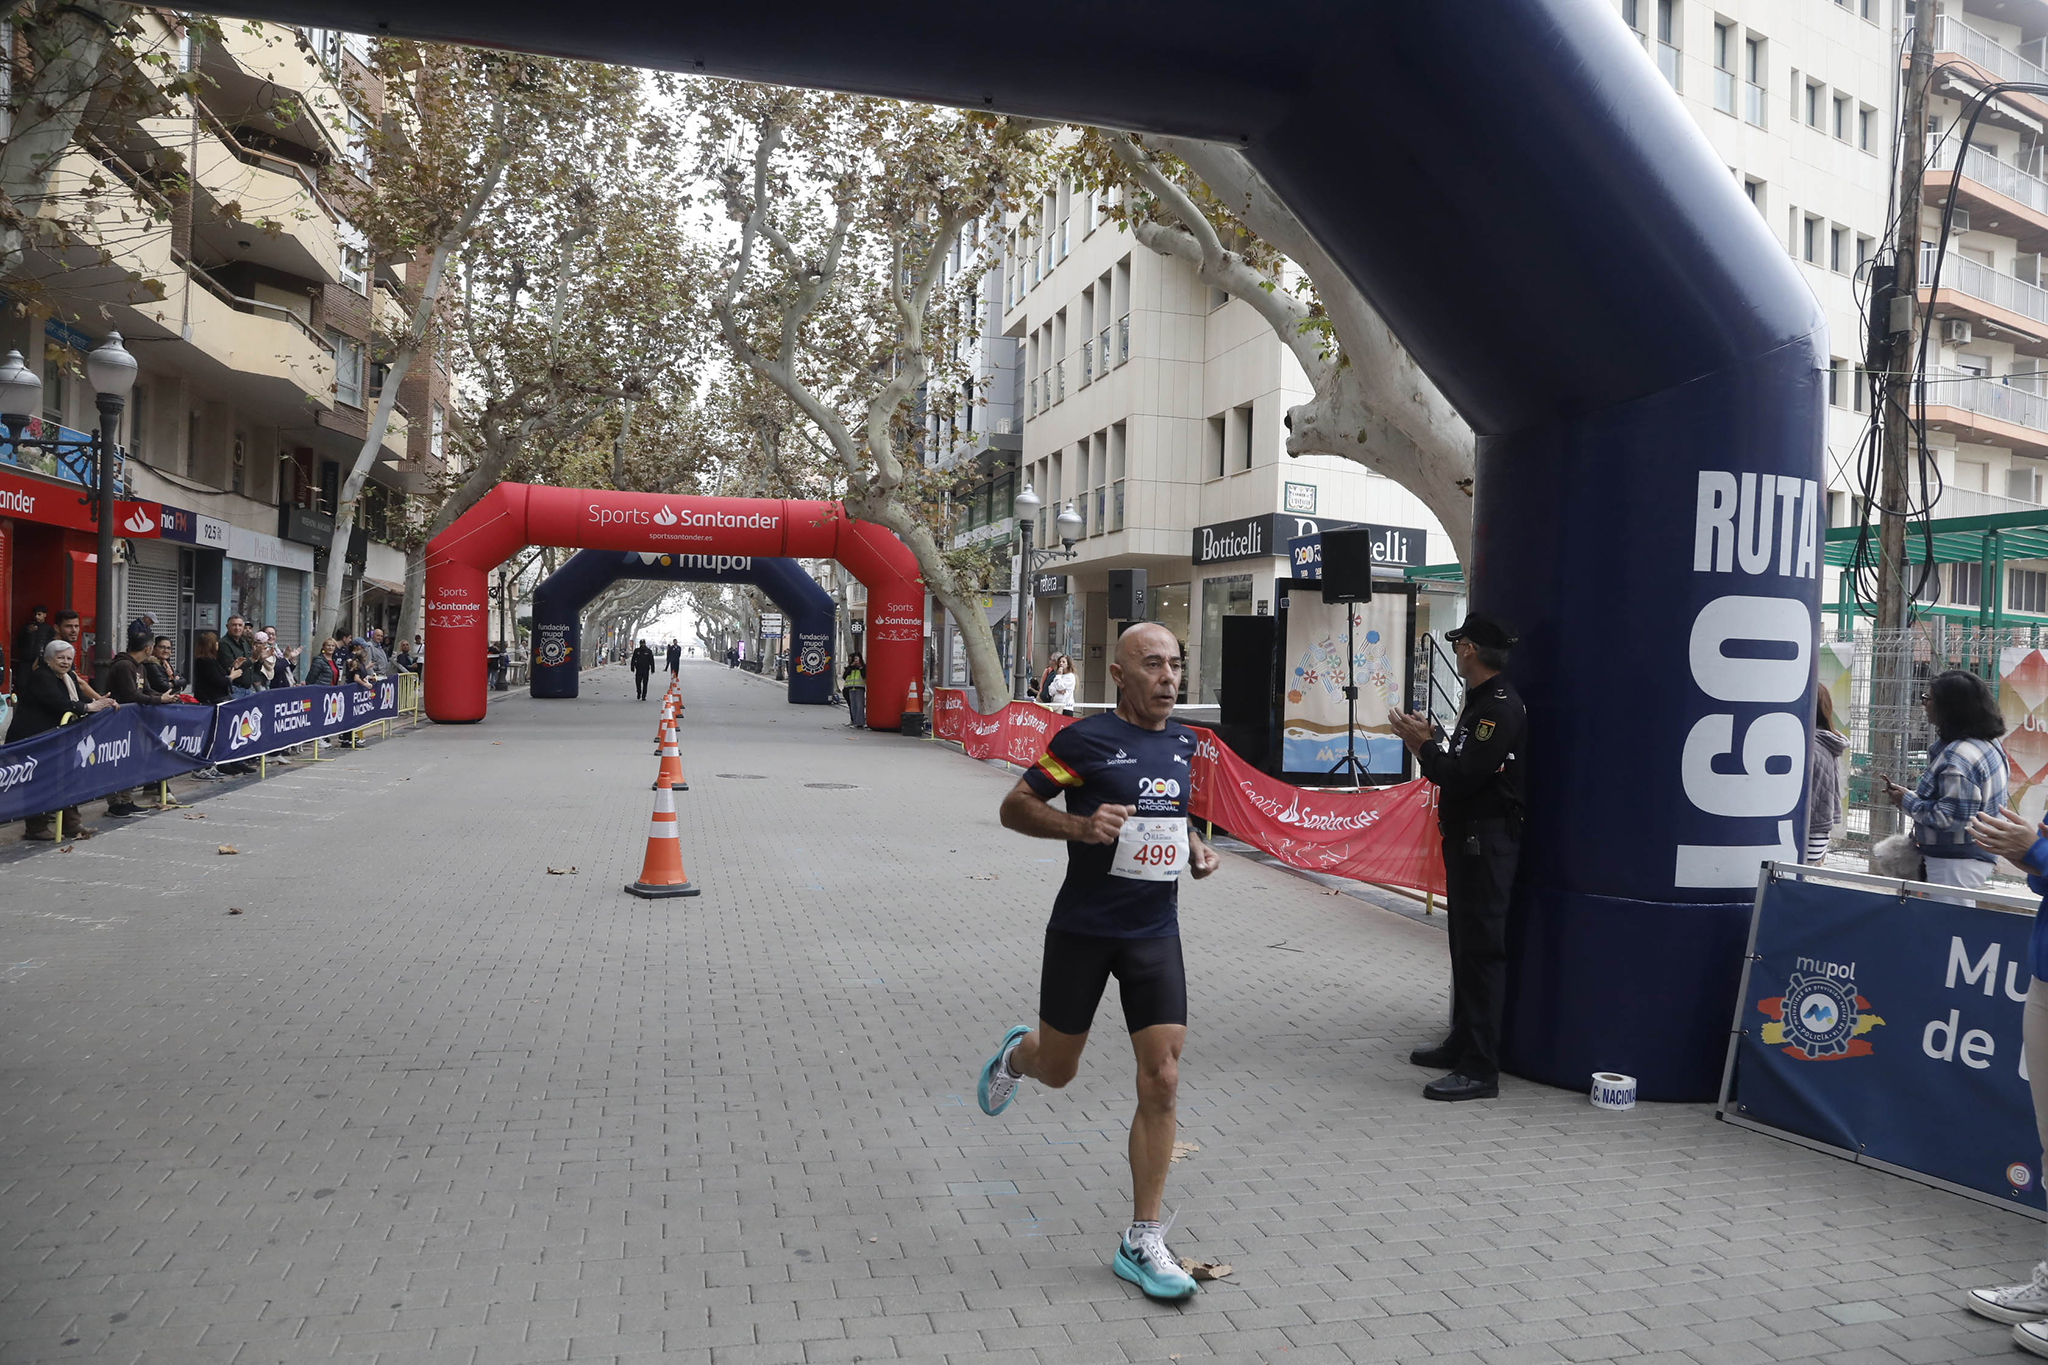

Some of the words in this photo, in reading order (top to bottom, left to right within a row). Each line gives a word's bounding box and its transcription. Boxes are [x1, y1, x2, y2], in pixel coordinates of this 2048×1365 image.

[175, 511, 187, 532] FM
[588, 504, 650, 527] Sports
[680, 509, 780, 529] Santander
[1693, 470, 1818, 579] RUTA
[649, 533, 713, 543] sportssantander.es
[1201, 521, 1261, 561] Botticelli
[679, 553, 751, 574] mupol
[1295, 545, 1314, 566] 200
[438, 587, 468, 598] Sports
[1040, 574, 1057, 592] rebeca
[436, 602, 481, 611] Santander
[887, 602, 914, 612] Sports
[538, 623, 570, 632] fundación
[885, 616, 923, 626] Santander
[542, 630, 564, 638] mupol
[799, 633, 830, 641] fundación
[380, 682, 395, 710] 200
[323, 691, 345, 726] 200
[274, 714, 311, 734] NACIONAL
[97, 731, 131, 767] mupol
[1675, 595, 1812, 889] 091
[1138, 777, 1181, 798] 200
[1133, 844, 1176, 866] 499
[1796, 956, 1856, 981] mupol
[1922, 1008, 1995, 1070] de
